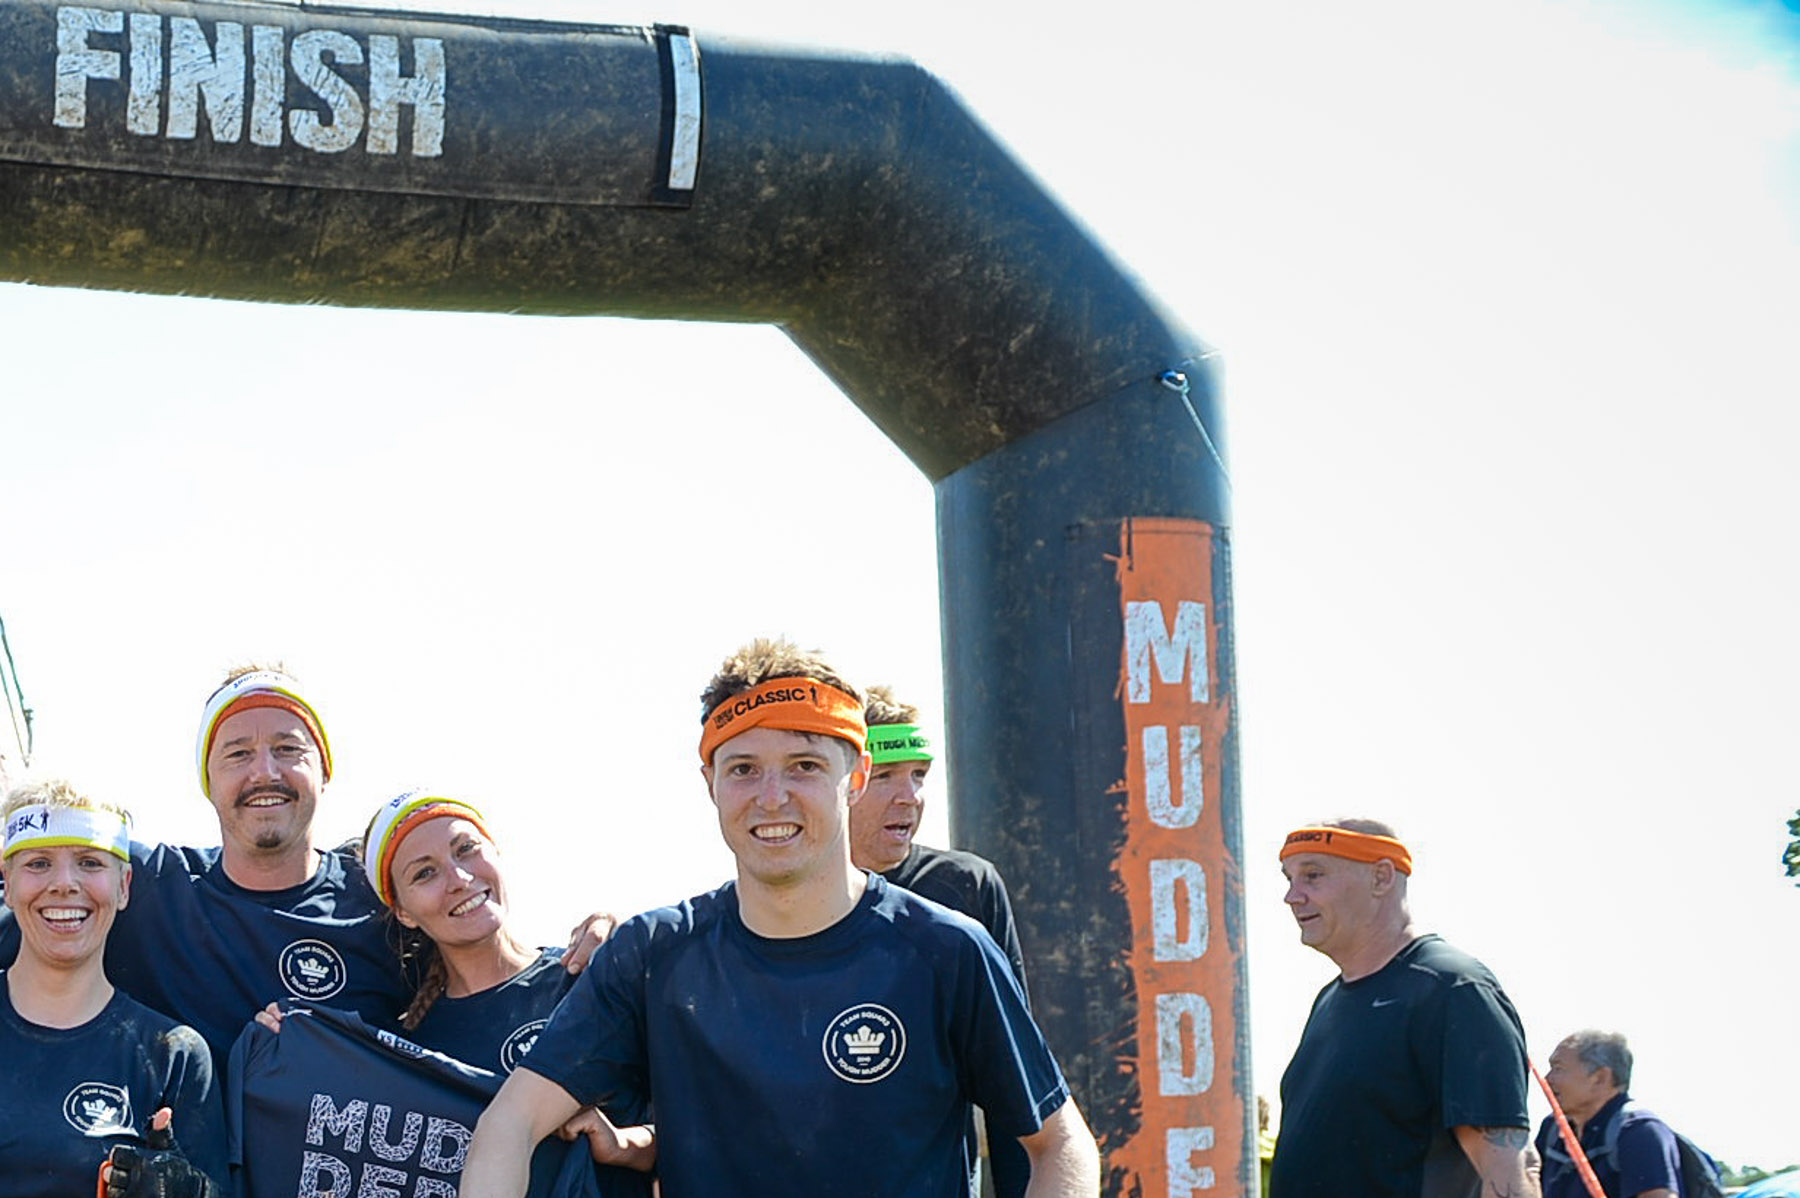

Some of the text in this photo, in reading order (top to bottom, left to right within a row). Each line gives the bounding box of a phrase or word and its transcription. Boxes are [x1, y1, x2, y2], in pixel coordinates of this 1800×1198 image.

[53, 7, 444, 158] FINISH
[734, 688, 805, 716] CLASSIC
[19, 813, 40, 832] 5K
[306, 1094, 474, 1174] MUD
